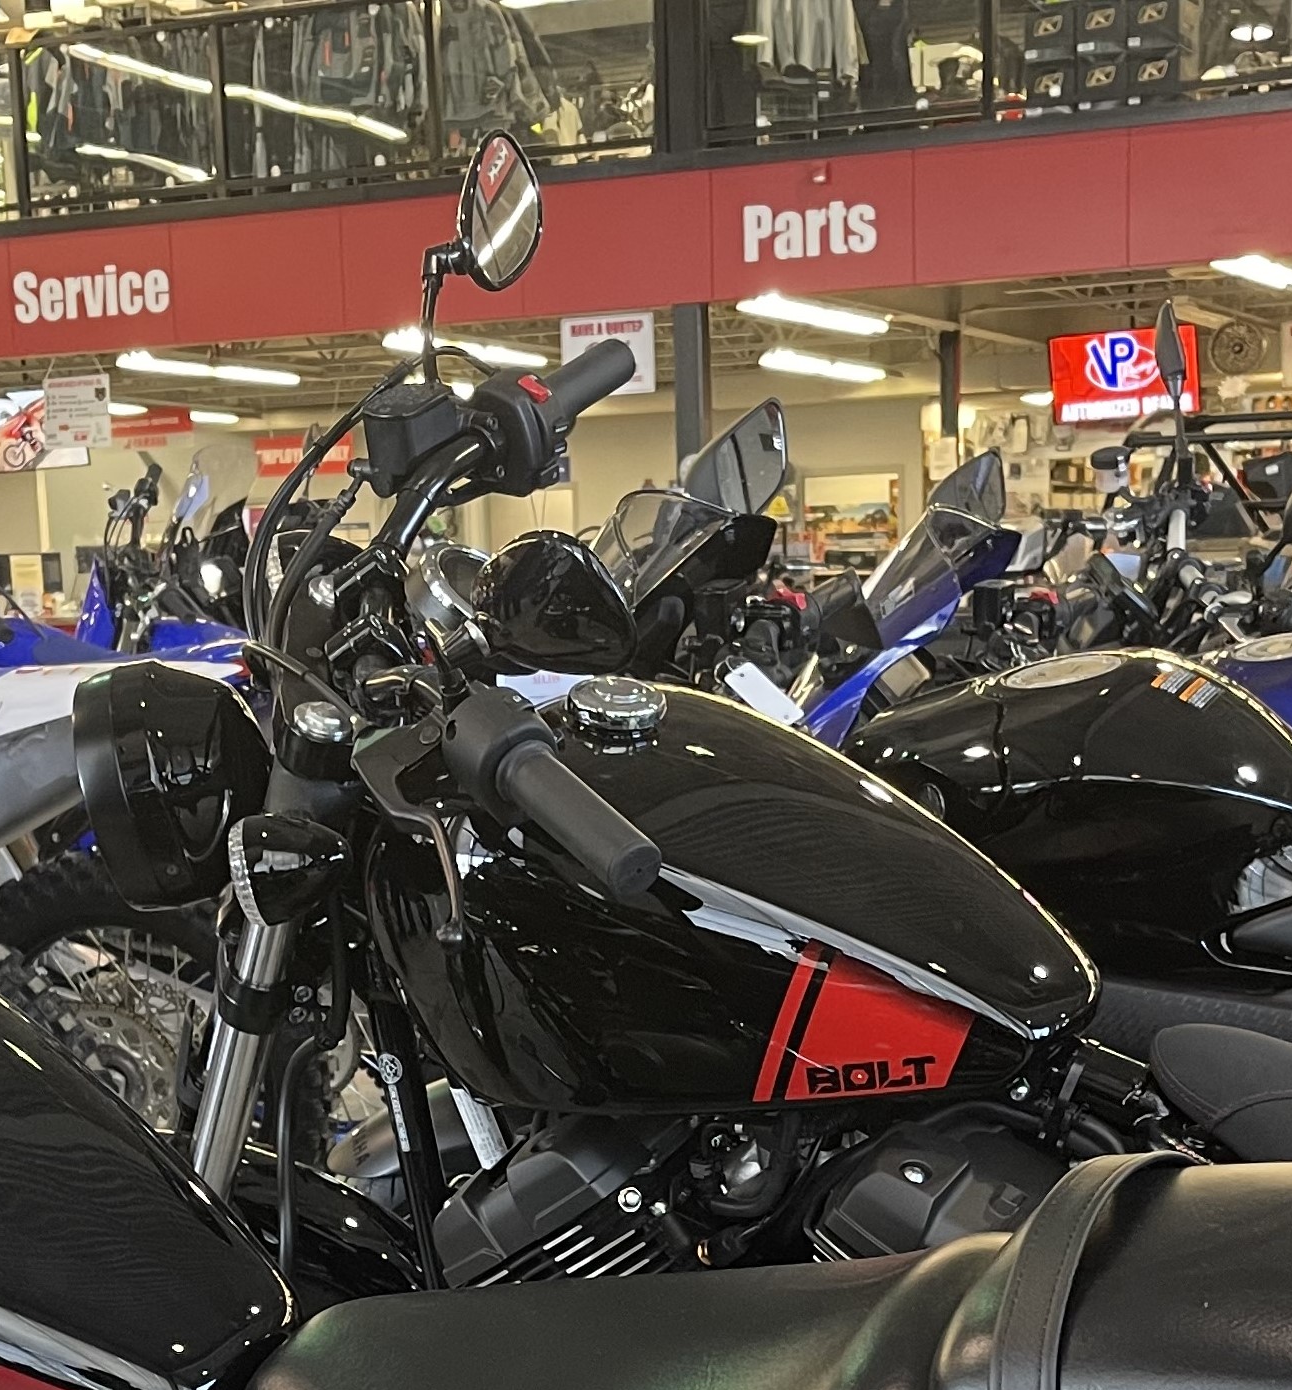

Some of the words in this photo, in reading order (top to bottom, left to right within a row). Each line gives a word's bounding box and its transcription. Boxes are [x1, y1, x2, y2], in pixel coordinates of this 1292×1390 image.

[743, 200, 877, 262] Parts
[13, 264, 170, 324] Service
[806, 1055, 936, 1094] BOLT
